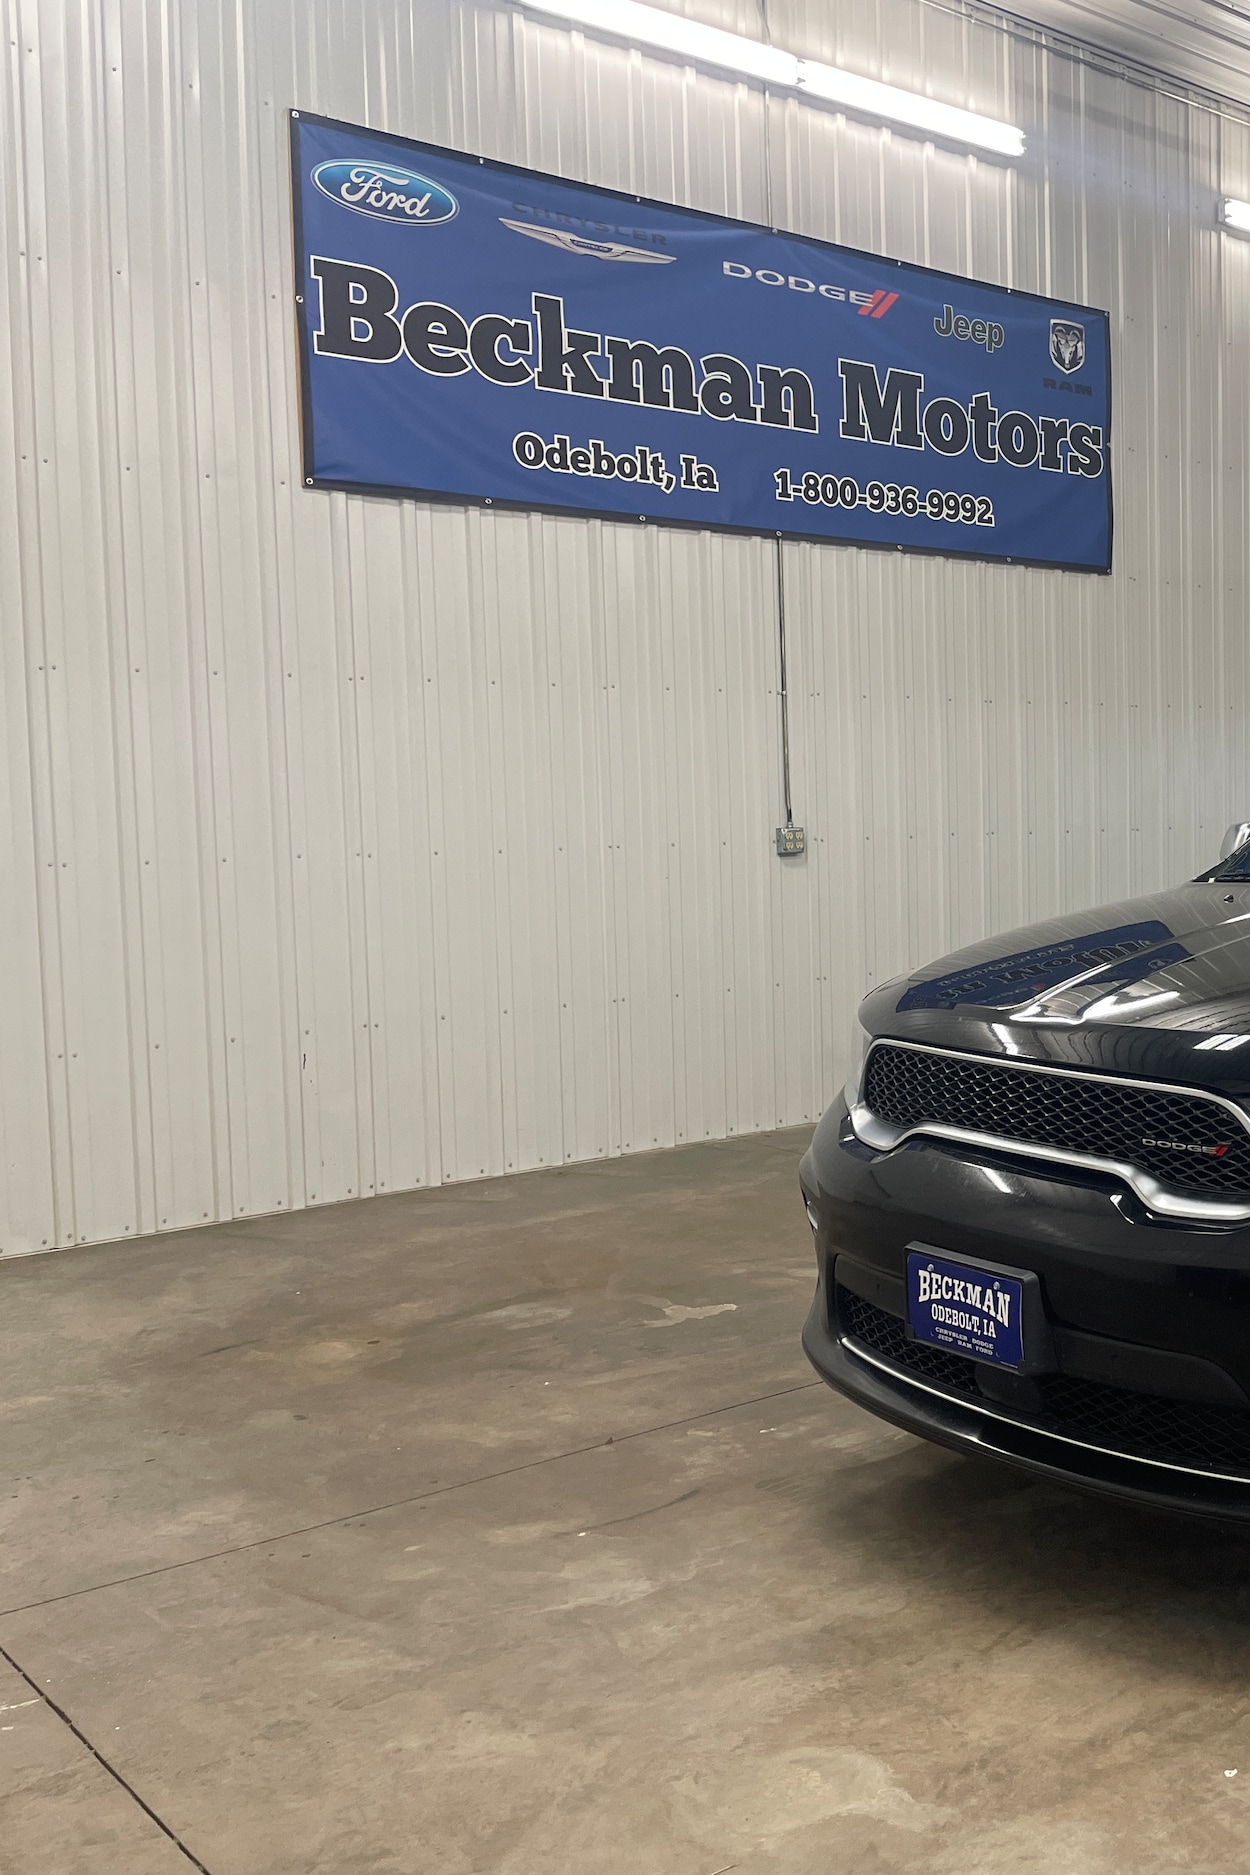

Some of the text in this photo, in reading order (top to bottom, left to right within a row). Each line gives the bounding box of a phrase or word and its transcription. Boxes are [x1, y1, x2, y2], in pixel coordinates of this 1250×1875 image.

[340, 166, 432, 219] Ford
[510, 202, 668, 246] CHRYSLER
[721, 260, 876, 308] DODGE
[933, 304, 1005, 353] Jeep
[310, 254, 1103, 479] Beckman Motors
[1042, 377, 1093, 397] RAM
[512, 431, 720, 494] Odebolt, Ia
[773, 468, 996, 528] 1-800-936-9992
[1142, 1138, 1218, 1155] DODGE
[918, 1269, 1011, 1328] BECKMAN
[931, 1303, 997, 1339] ODEBOLT, IA
[934, 1326, 994, 1350] CHRYSLER DODGE
[937, 1334, 994, 1356] JEEP RAM FORD
